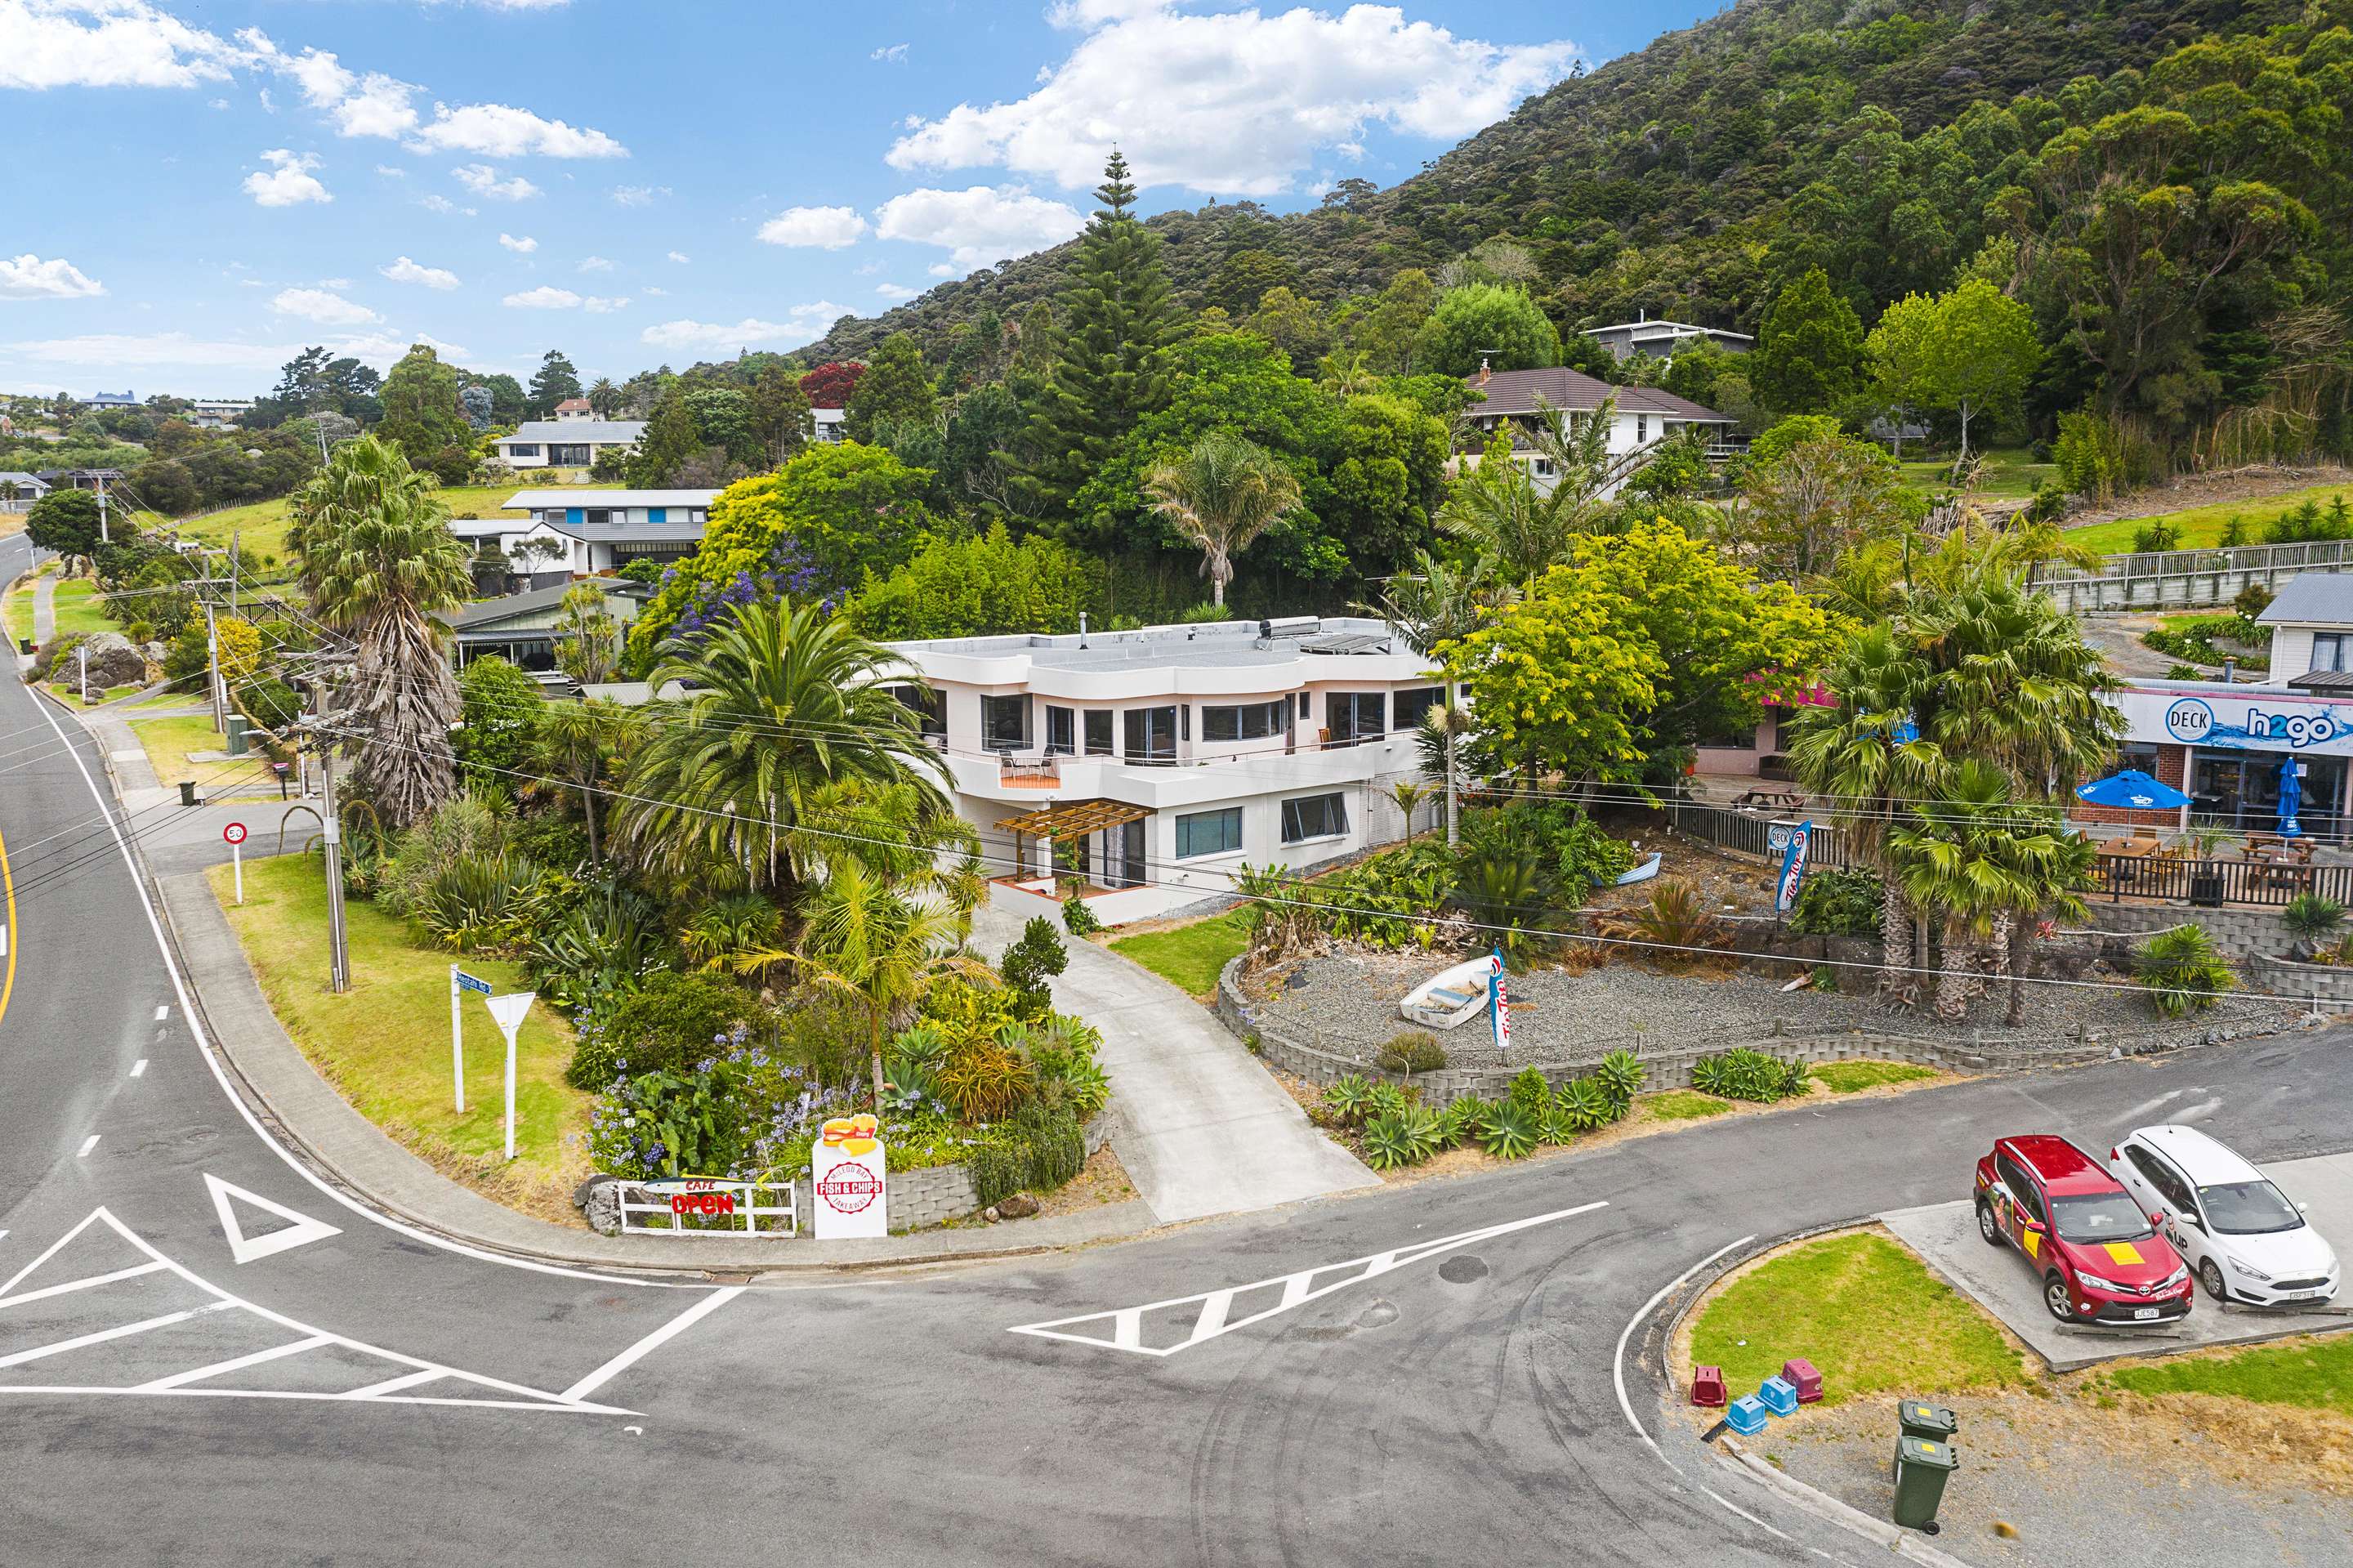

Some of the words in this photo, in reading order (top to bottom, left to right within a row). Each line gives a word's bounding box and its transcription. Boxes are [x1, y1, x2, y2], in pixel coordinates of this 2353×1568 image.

[2171, 711, 2208, 728] DECK
[2248, 708, 2335, 748] h2go
[230, 829, 243, 838] 50
[1772, 833, 1788, 842] DECK
[856, 1168, 869, 1179] BAY
[685, 1178, 716, 1191] CAFE
[819, 1182, 842, 1194] FISH
[842, 1183, 851, 1194] &
[851, 1182, 880, 1193] CHIPS
[832, 1196, 868, 1209] TAKEAWAY
